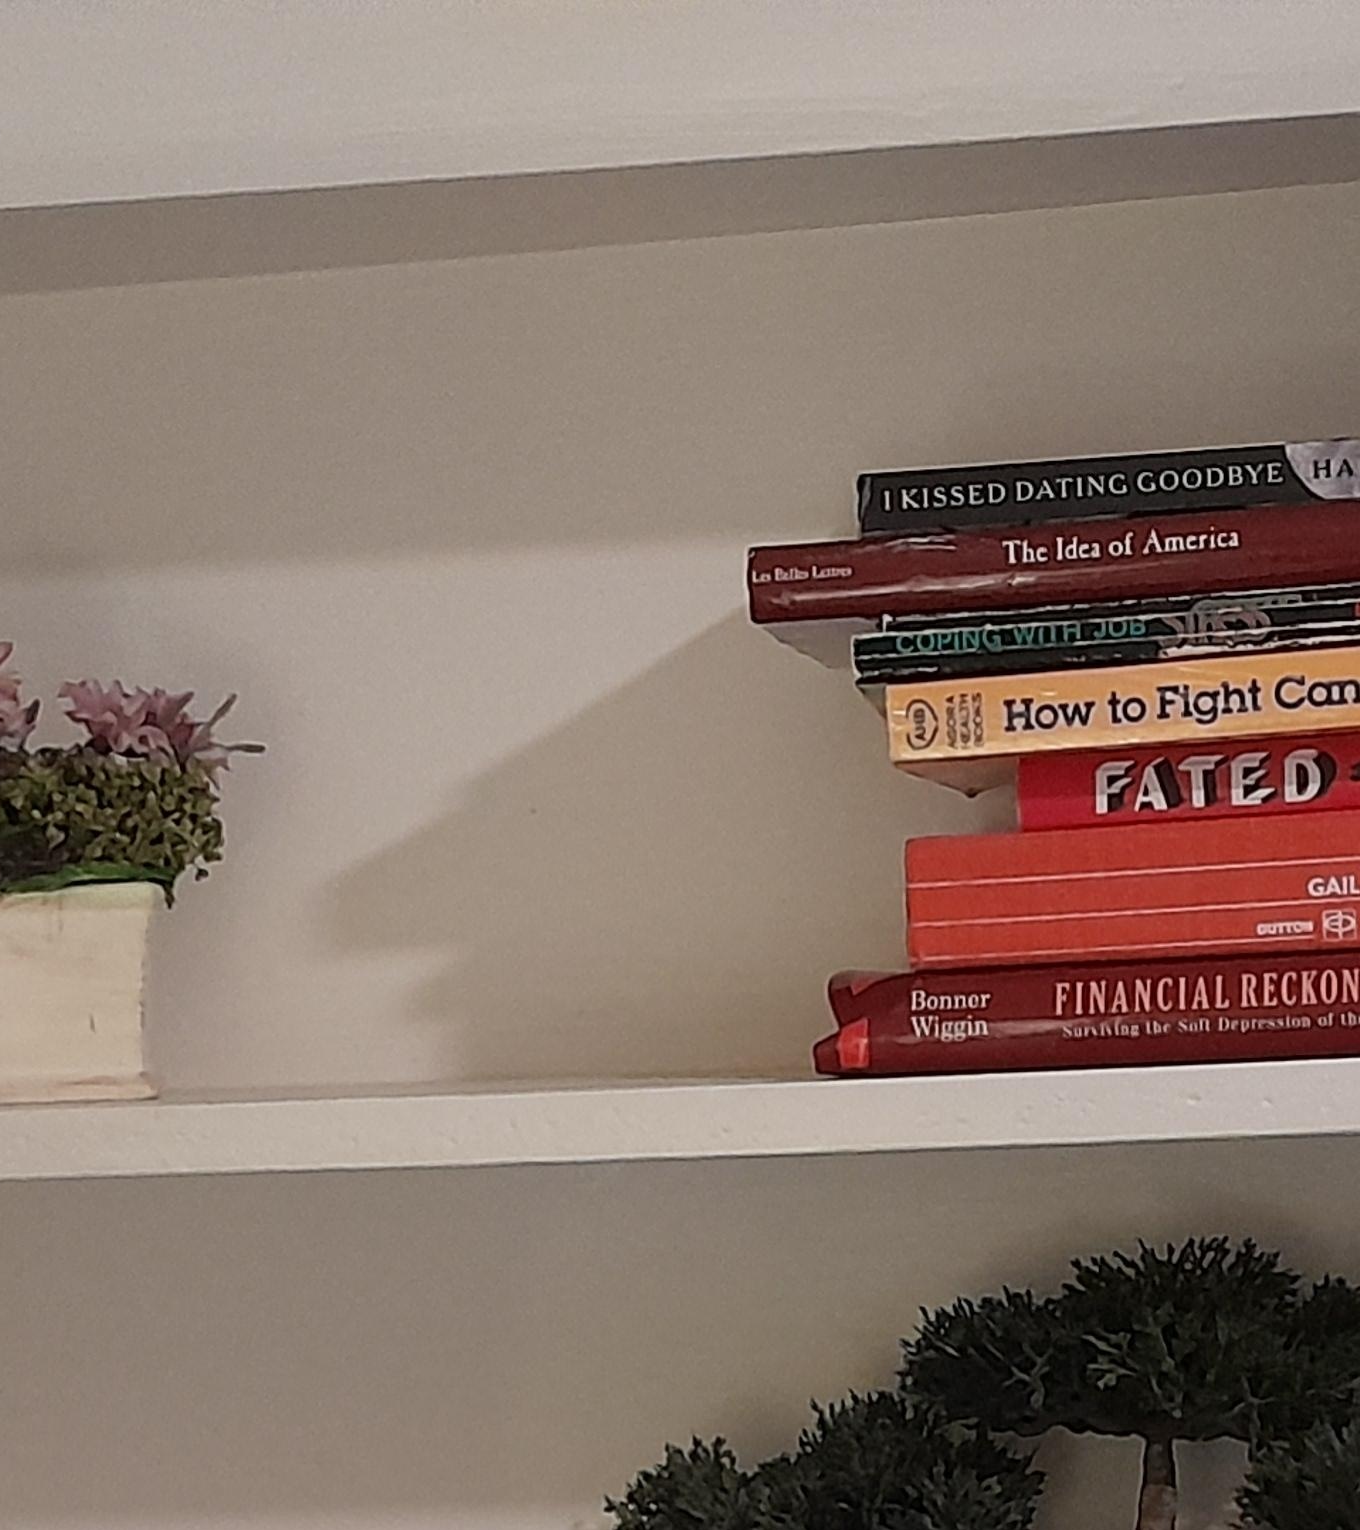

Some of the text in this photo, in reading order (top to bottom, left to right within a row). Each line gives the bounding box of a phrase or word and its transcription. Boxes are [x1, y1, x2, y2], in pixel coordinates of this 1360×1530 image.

[883, 462, 1284, 512] I KISSED DATING GOODBYE
[1001, 526, 1239, 564] The Idea of America
[895, 628, 1003, 654] COPING
[1012, 620, 1082, 647] WITH
[1092, 616, 1147, 640] JOB
[1004, 698, 1096, 732] How
[1107, 691, 1147, 725] to
[1156, 678, 1262, 725] Fight
[1094, 748, 1335, 815] FATED
[1307, 876, 1360, 898] GAIL
[910, 990, 990, 1013] Bonner
[1054, 974, 1230, 1016] FINANCIAL
[910, 1016, 990, 1043] Wiggin
[1145, 1020, 1172, 1034] the
[1217, 1013, 1312, 1034] Depression
[1317, 1011, 1335, 1027] of
